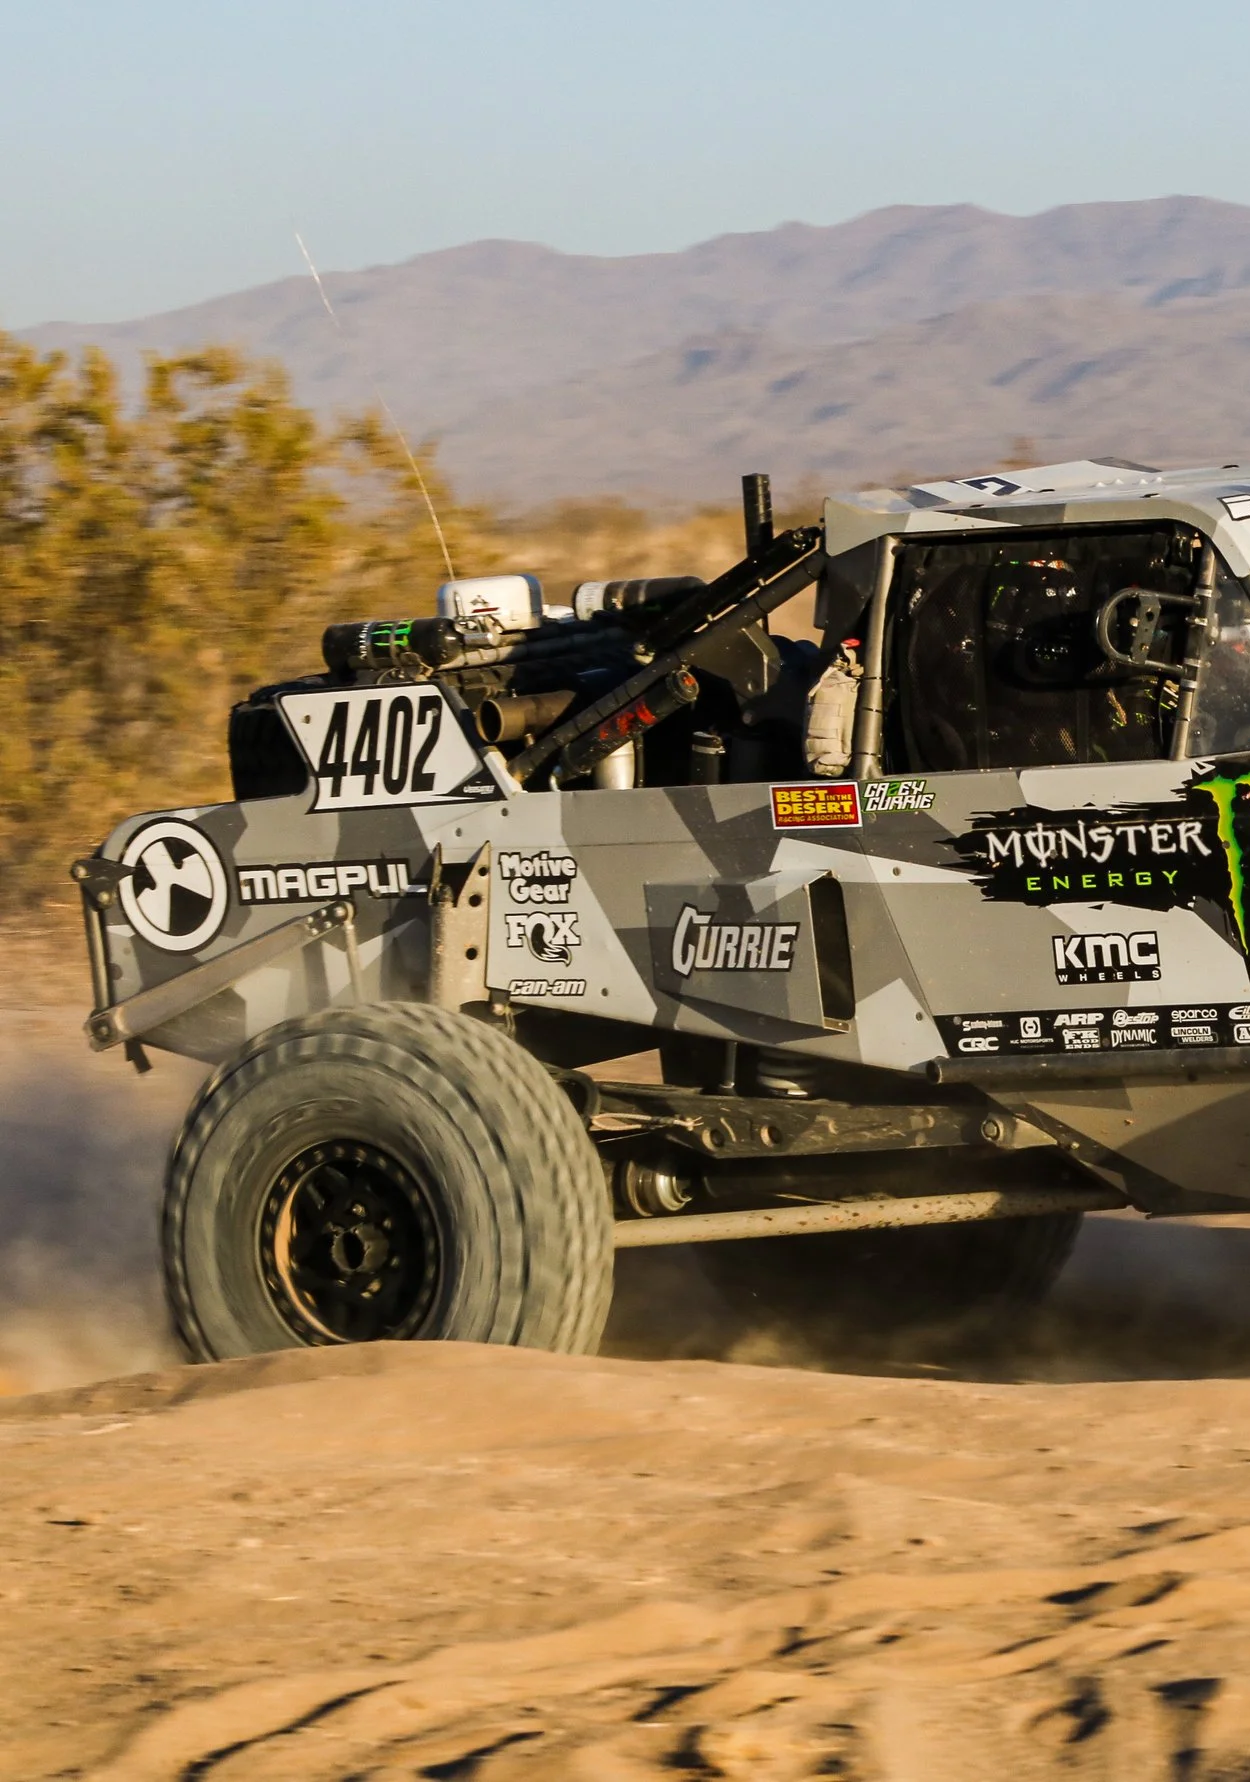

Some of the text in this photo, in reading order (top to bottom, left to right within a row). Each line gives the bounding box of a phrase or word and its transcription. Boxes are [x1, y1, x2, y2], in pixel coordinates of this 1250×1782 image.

[317, 695, 442, 797] 4402
[776, 790, 828, 802] BEST
[865, 794, 935, 811] CURRIE
[777, 801, 853, 815] DESERT
[778, 815, 805, 823] RACING
[986, 820, 1212, 868] MONSTER
[500, 852, 577, 879] Motive
[238, 863, 428, 901] MAGPUL
[1026, 870, 1178, 891] ENERGY
[509, 878, 570, 903] Gear
[505, 911, 581, 966] FOX
[1053, 933, 1159, 969] KMC
[1058, 970, 1160, 983] WHEELS
[509, 979, 586, 996] can-am
[1053, 1012, 1104, 1026] ARP
[1171, 1009, 1218, 1022] sparco
[1111, 1029, 1157, 1047] DYNAMIC
[1172, 1027, 1210, 1036] LINCOLN
[958, 1037, 999, 1052] CRC
